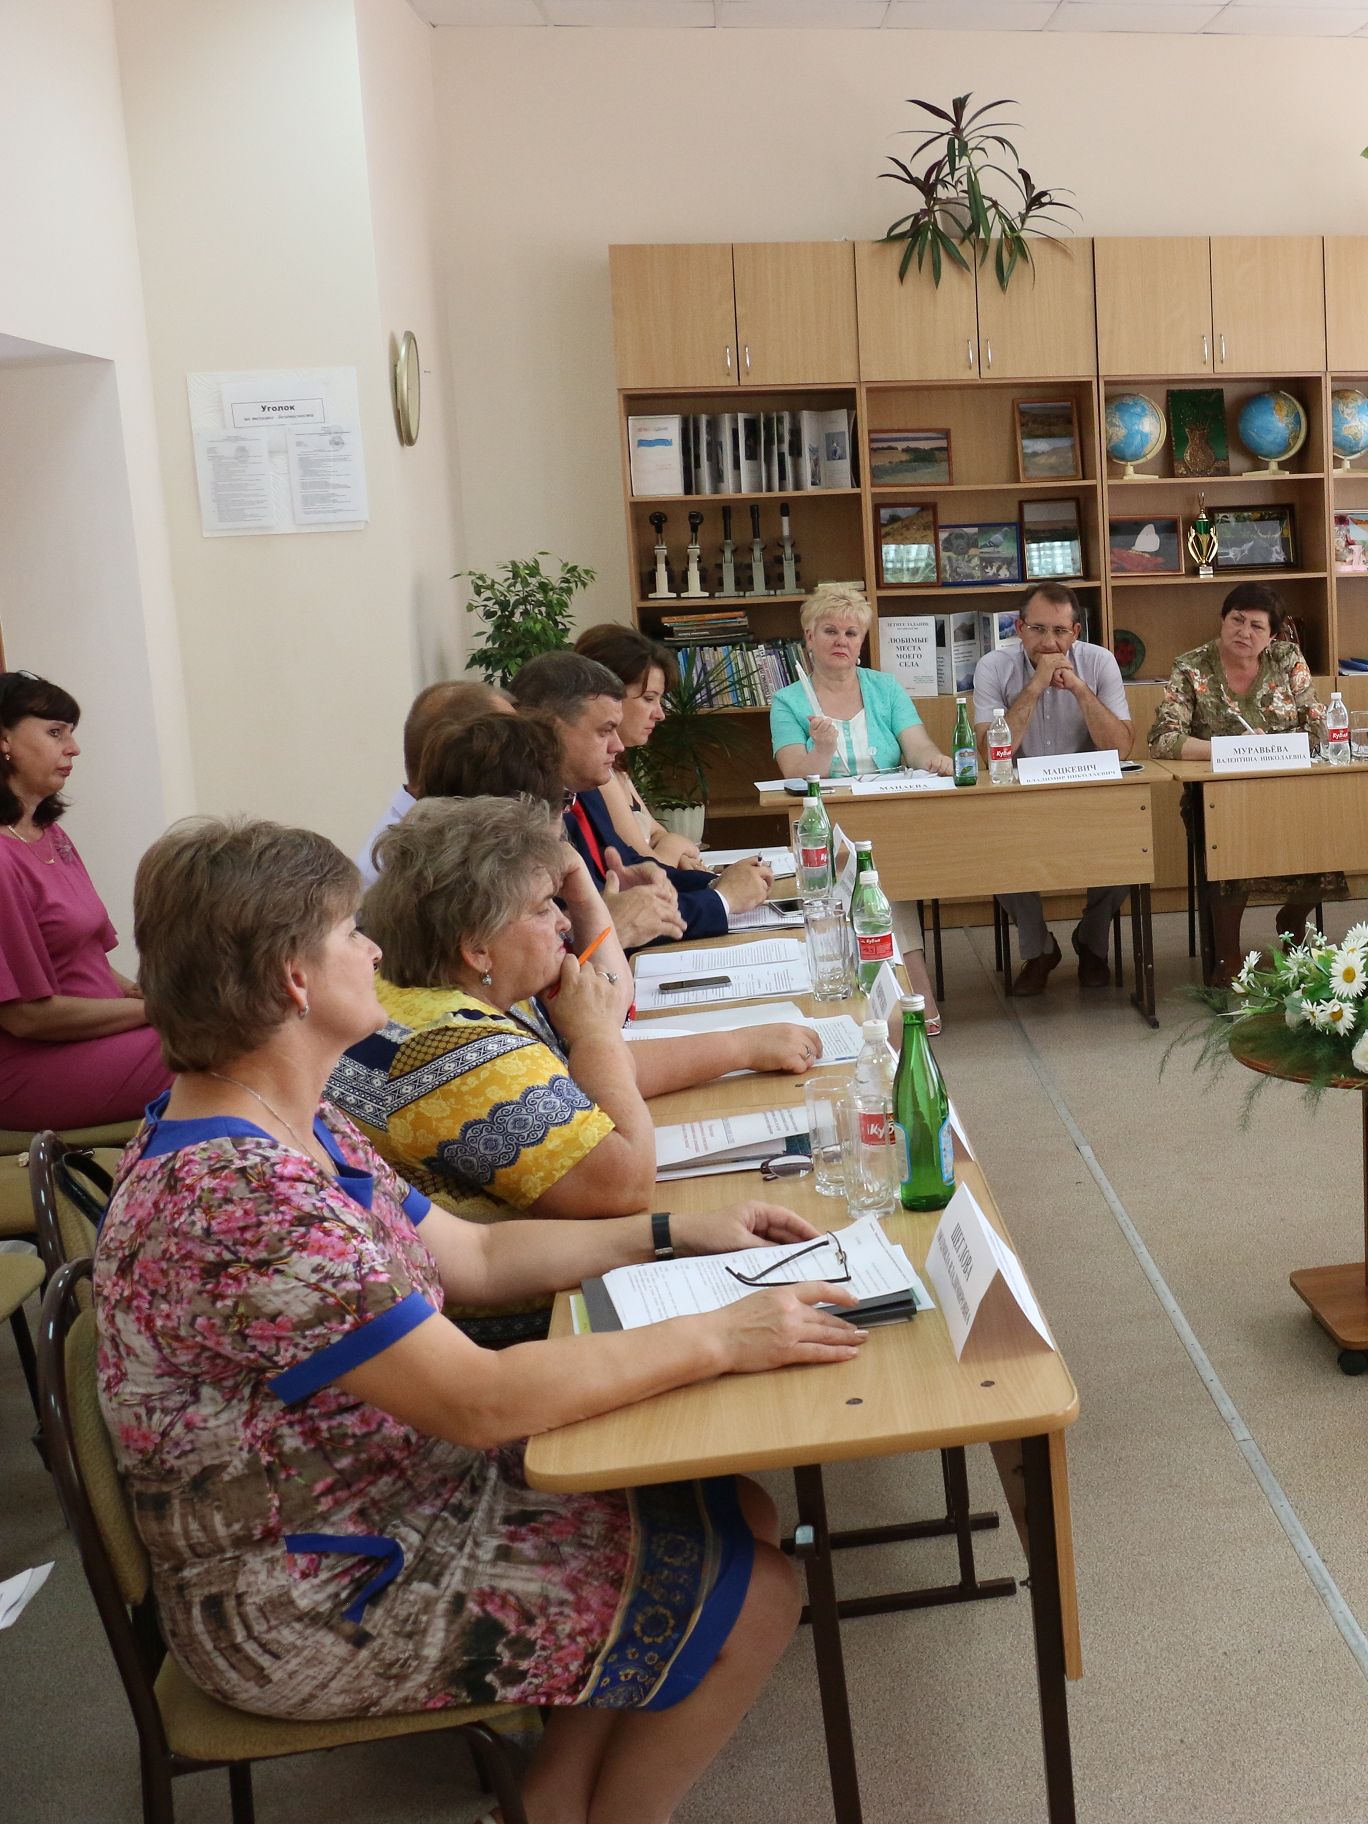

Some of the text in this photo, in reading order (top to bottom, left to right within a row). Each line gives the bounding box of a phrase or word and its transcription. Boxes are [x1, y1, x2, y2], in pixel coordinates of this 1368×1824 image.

[1233, 744, 1289, 755] МУРАВЬЁВА
[1216, 754, 1307, 764] ВАЛЕНТИНА НИКОЛАЕВНА
[1043, 764, 1097, 776] МАЦКЕВИЧ
[1067, 770, 1116, 780] НИКОЛАЕВИЧ
[951, 1222, 973, 1282] ЩЕГЛОВА
